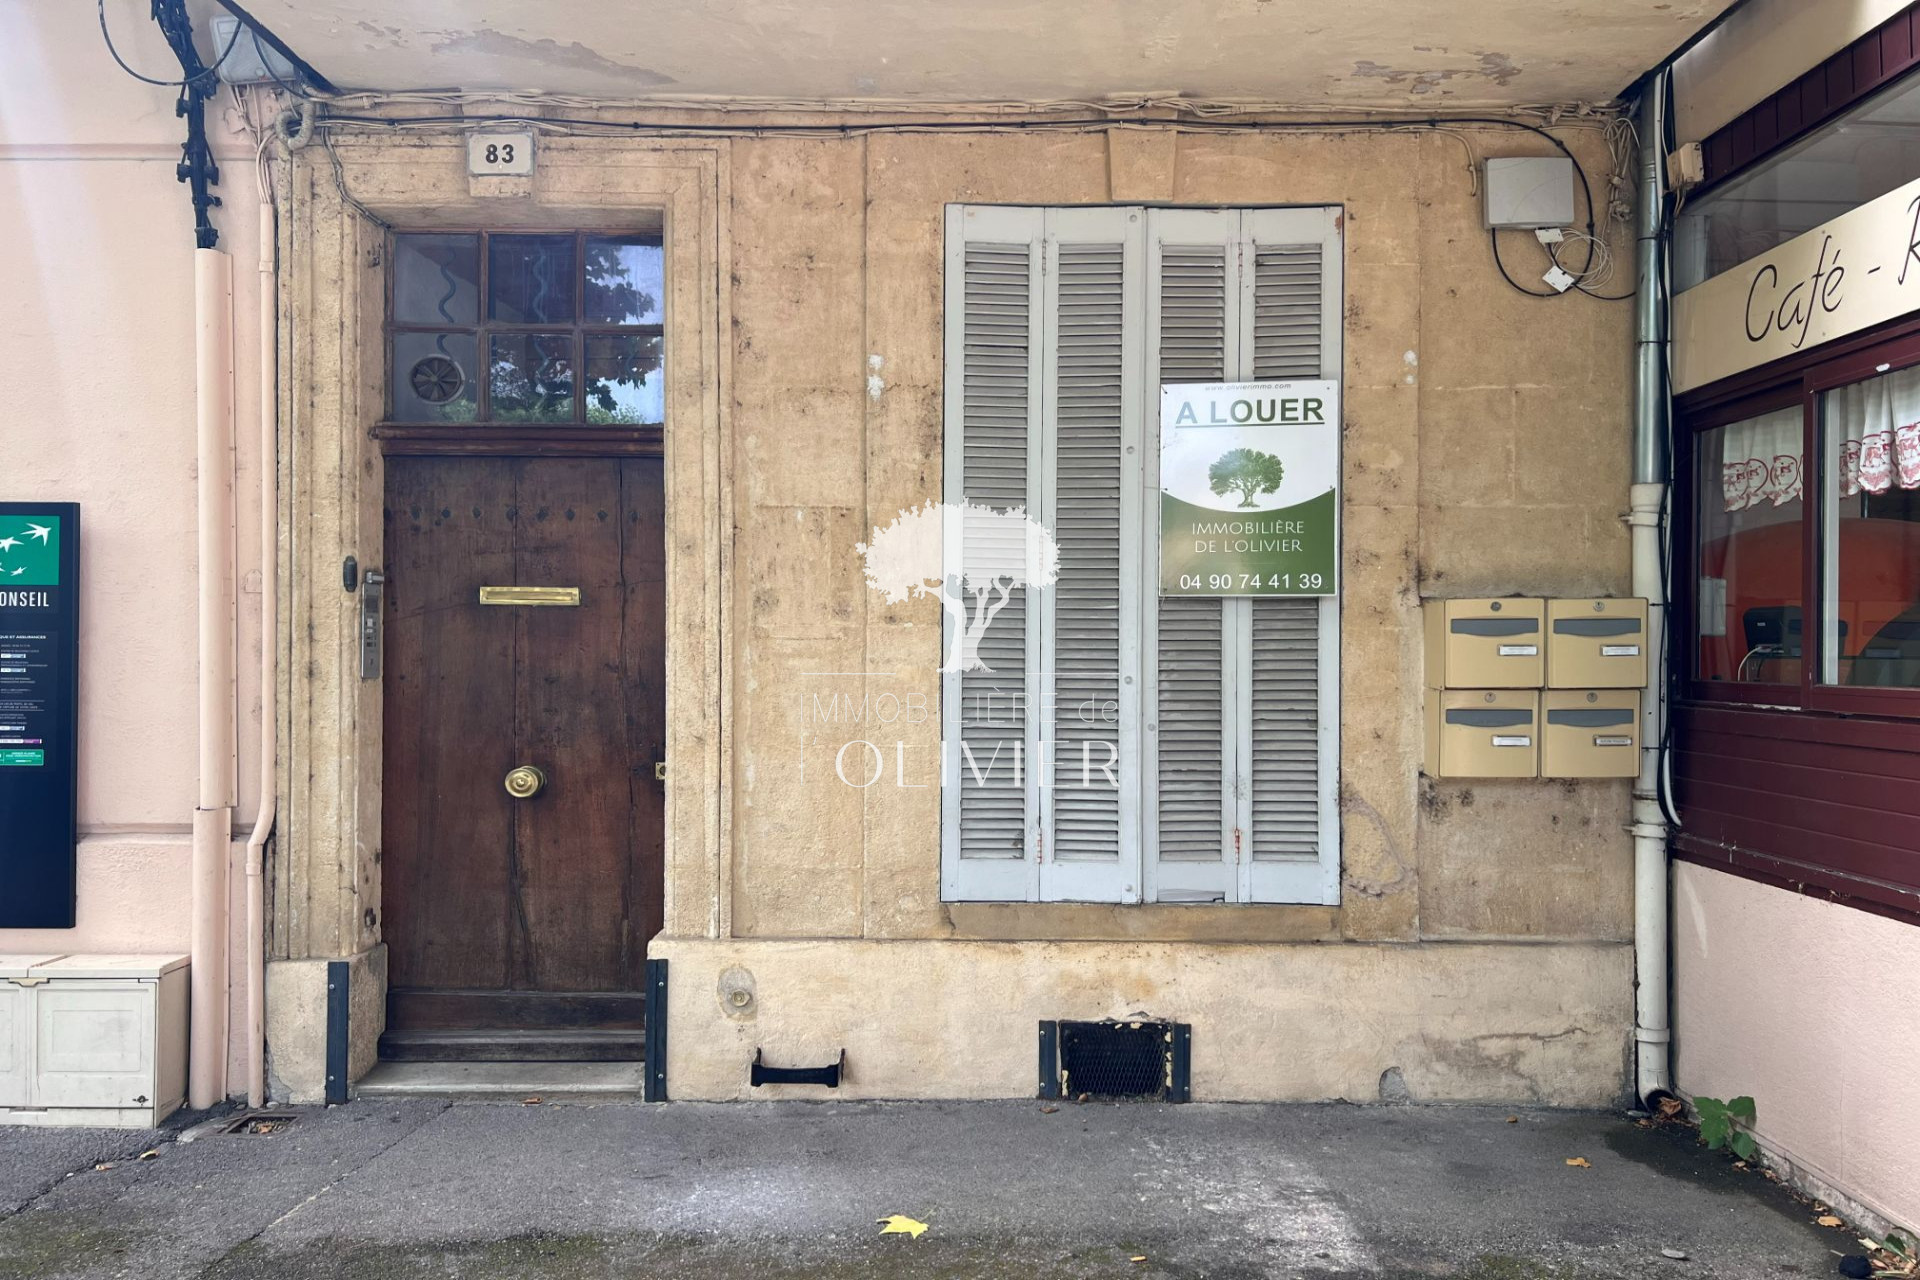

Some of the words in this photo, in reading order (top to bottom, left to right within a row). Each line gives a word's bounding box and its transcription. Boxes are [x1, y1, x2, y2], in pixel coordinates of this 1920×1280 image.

[485, 144, 514, 164] 83
[1745, 235, 1845, 348] Café
[1176, 401, 1198, 424] A
[1210, 398, 1324, 424] LOUER
[1192, 520, 1304, 535] IMMOBILIÈRE
[1195, 540, 1216, 553] DE
[1224, 539, 1303, 553] L'OLIVIER
[1180, 574, 1201, 589] 04
[1209, 574, 1232, 589] 90
[1239, 574, 1261, 588] 74
[1268, 574, 1291, 588] 41
[1299, 573, 1322, 588] 39
